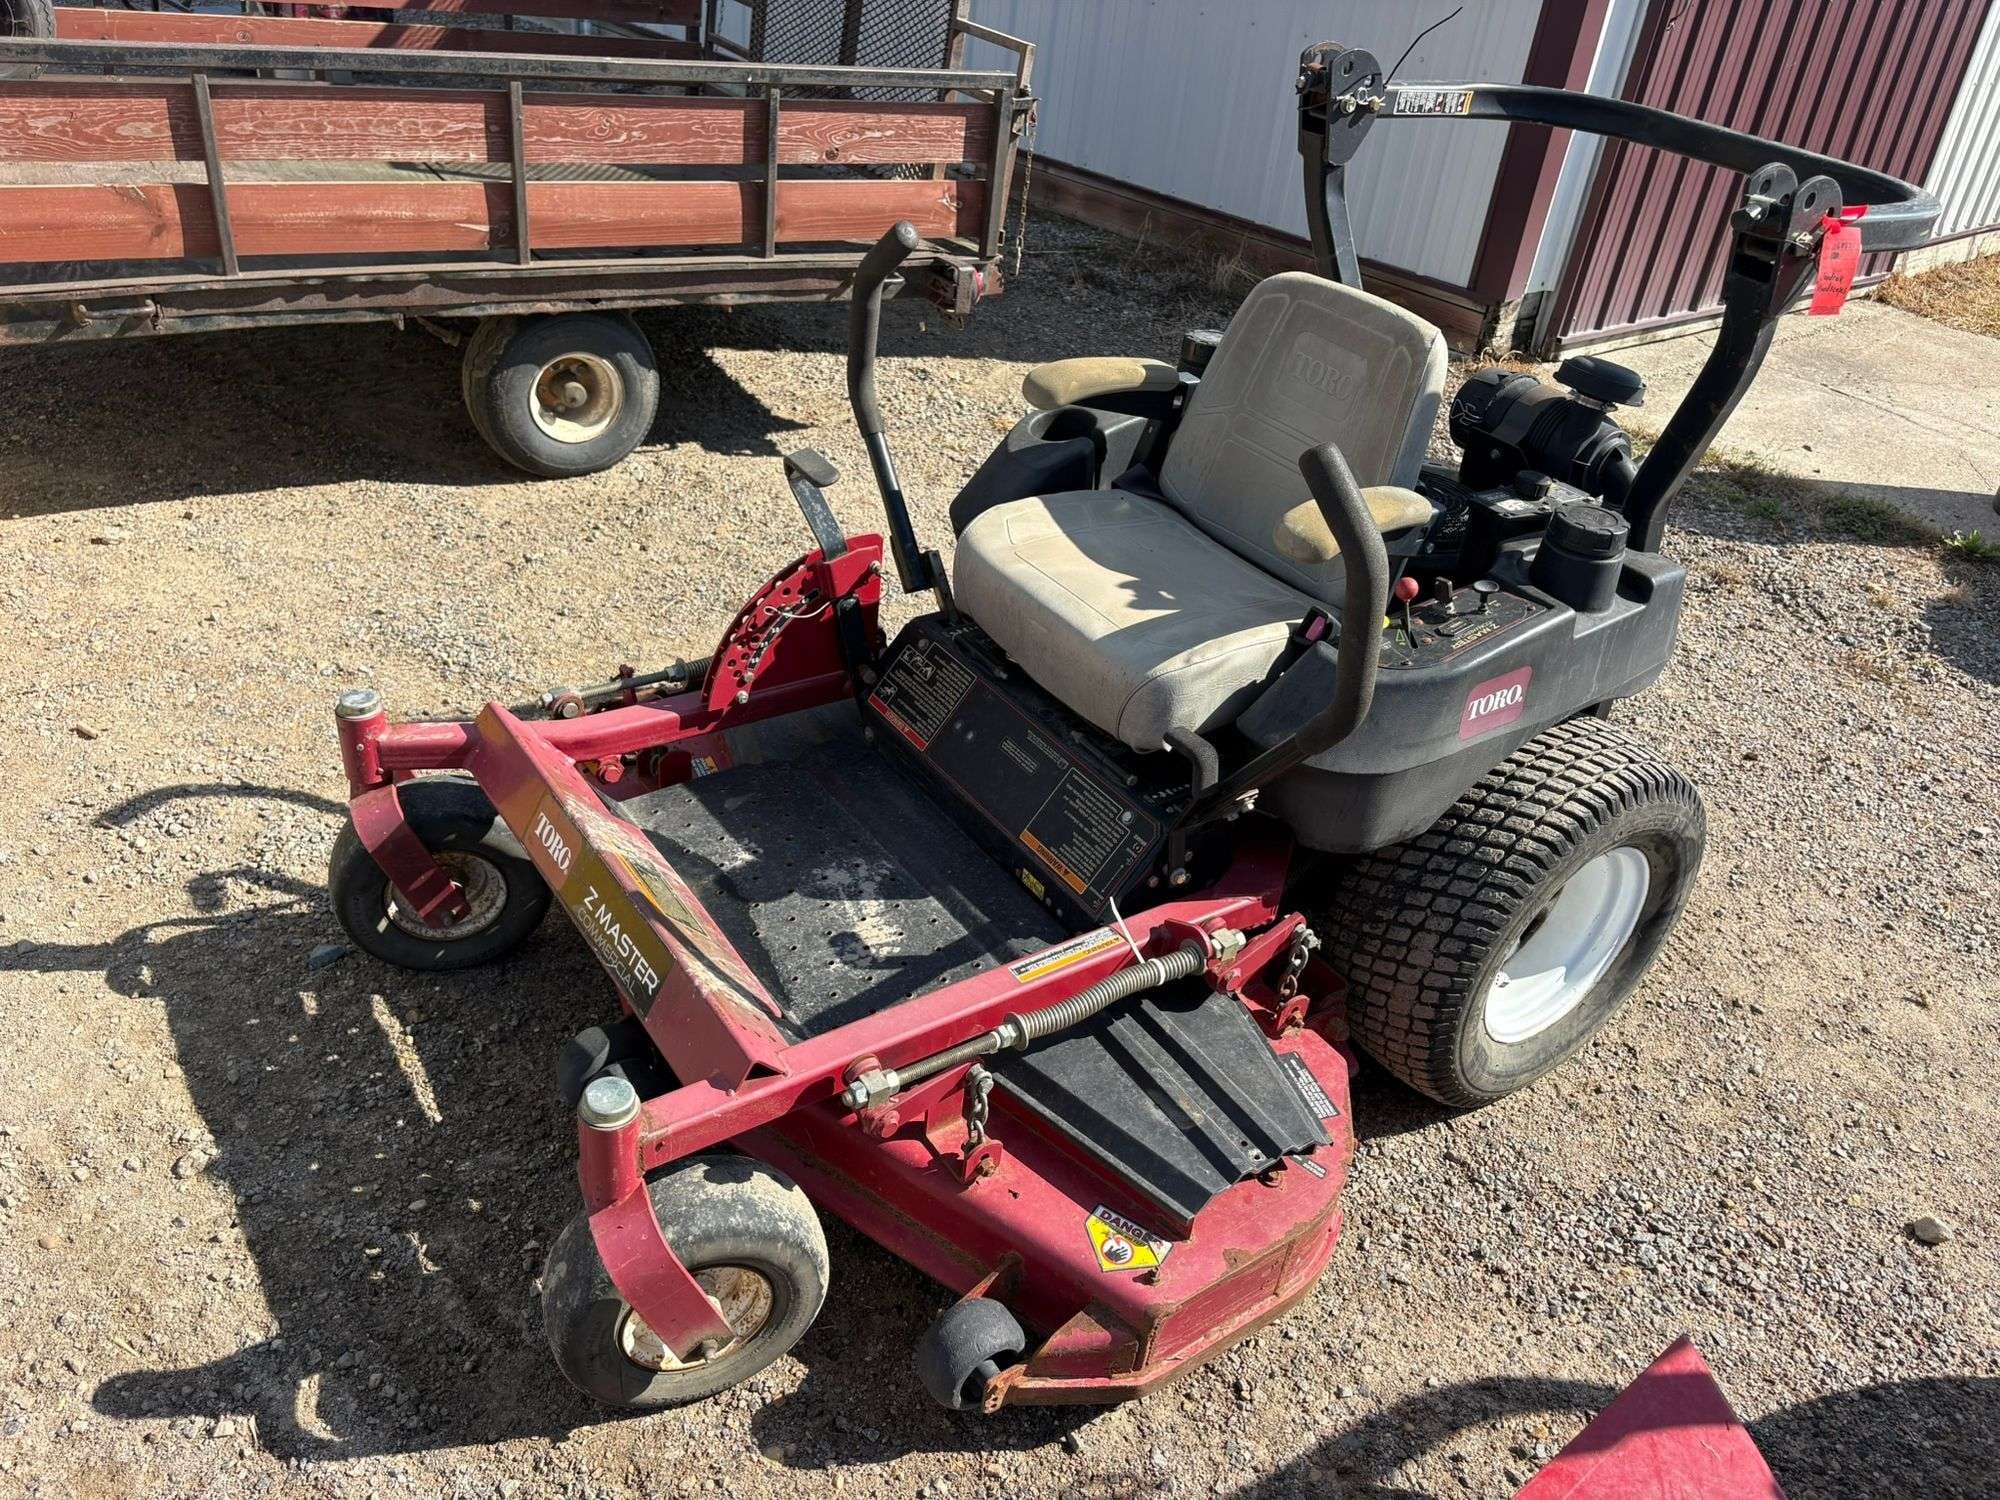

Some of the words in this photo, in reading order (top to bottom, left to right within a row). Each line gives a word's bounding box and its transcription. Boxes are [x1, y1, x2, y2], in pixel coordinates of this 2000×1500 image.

[1292, 352, 1352, 401] TORO
[1467, 684, 1523, 721] TORO
[534, 811, 571, 870] TORO
[577, 907, 637, 996] COMMERCIAL
[584, 886, 598, 908] Z
[598, 904, 659, 994] MASTER
